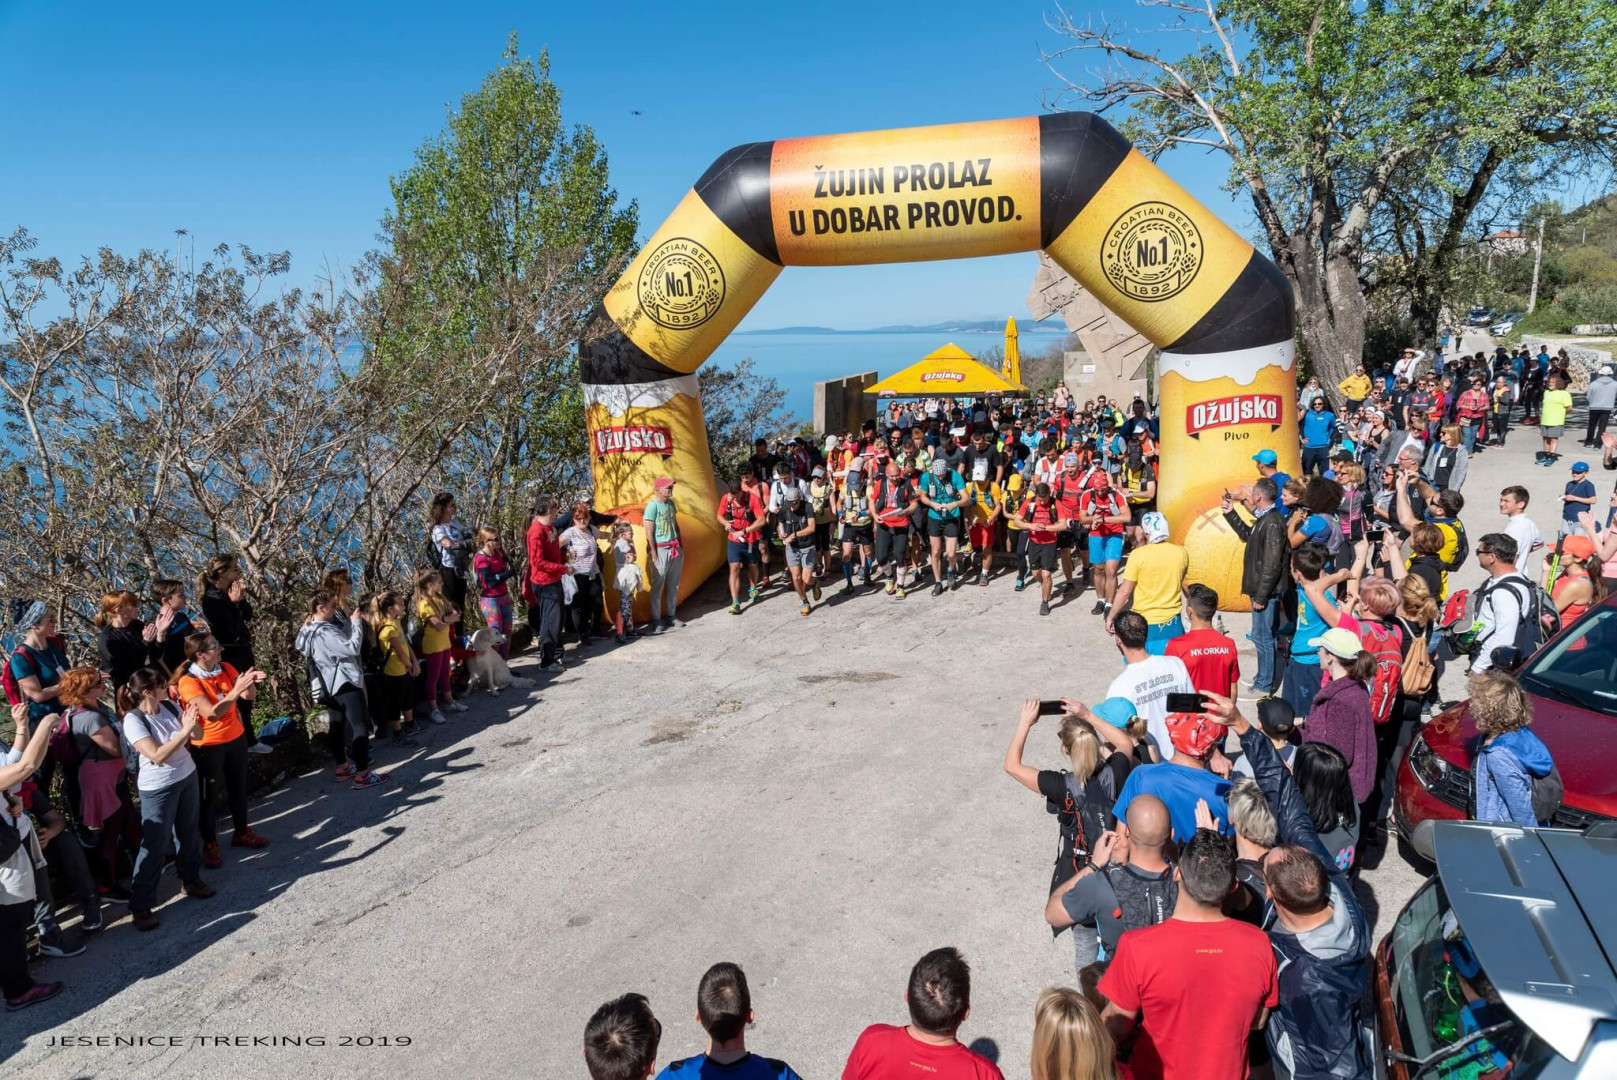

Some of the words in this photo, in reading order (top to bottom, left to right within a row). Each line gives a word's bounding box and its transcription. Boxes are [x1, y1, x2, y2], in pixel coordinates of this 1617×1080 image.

[814, 164, 884, 198] ŽUJIN
[893, 158, 992, 193] PROLAZ
[789, 209, 805, 236] U
[813, 203, 901, 235] DOBAR
[907, 195, 1022, 229] PROVOD.
[1109, 207, 1164, 248] CROATIAN
[1168, 211, 1194, 238] BEER
[645, 243, 688, 277] CROATIAN
[691, 247, 717, 275] BEER
[1136, 236, 1168, 268] No.1
[665, 271, 694, 297] No.1
[1133, 283, 1171, 295] 1892
[665, 312, 700, 323] 1892
[1193, 396, 1277, 429] Ožujsko
[597, 426, 667, 453] Ožujsko
[1224, 431, 1250, 441] Pivo
[1190, 648, 1202, 657] NK
[1203, 647, 1229, 655] ORKAN
